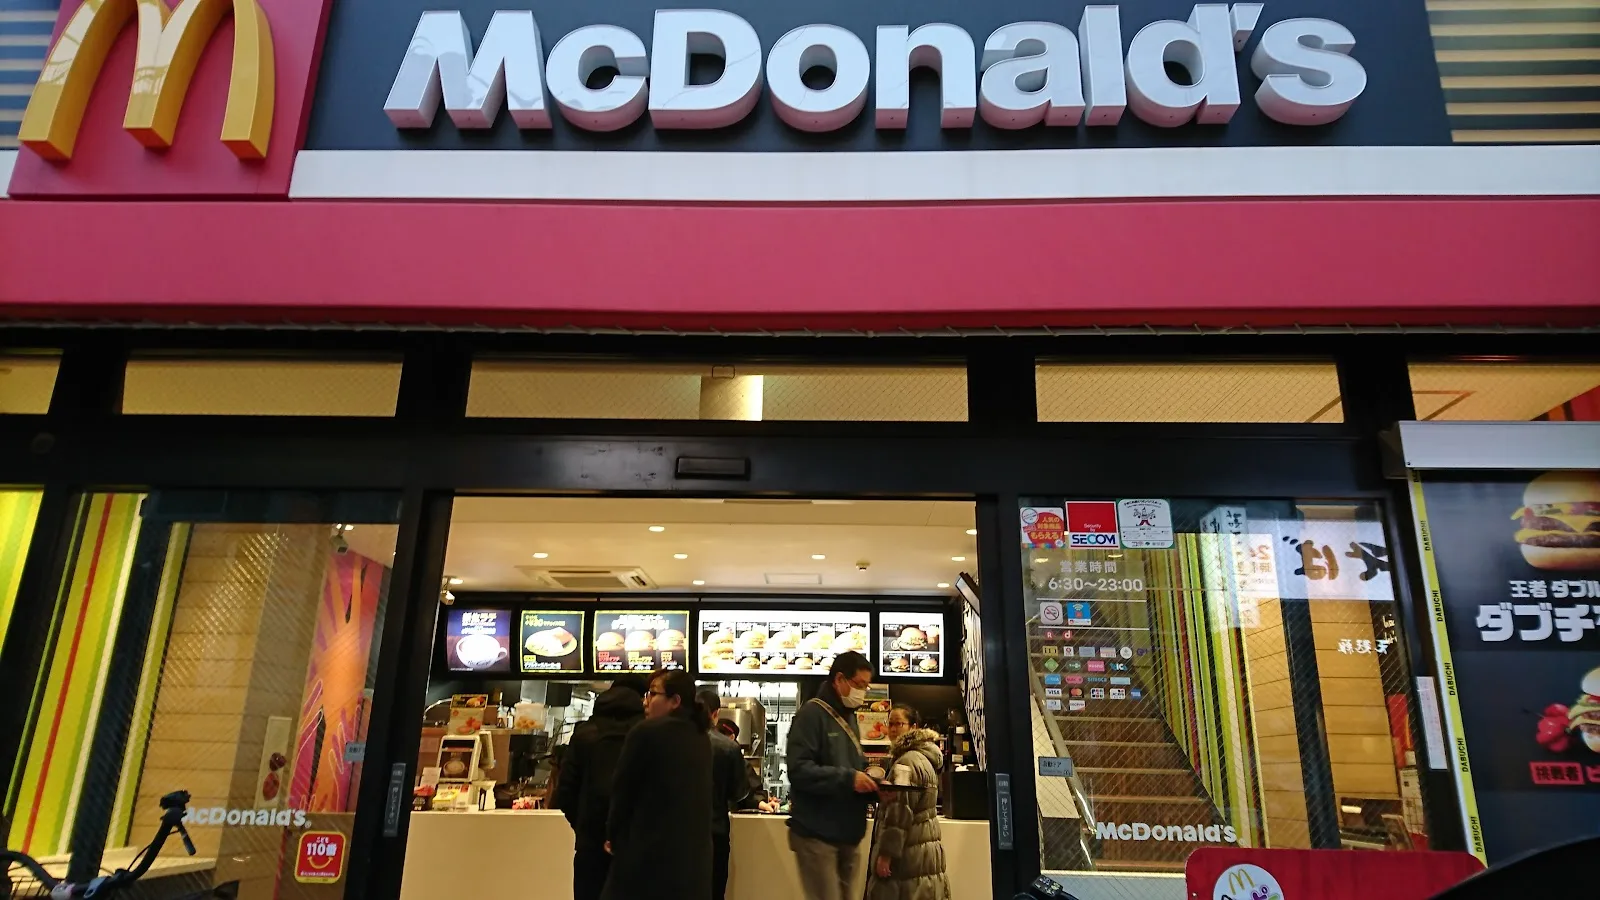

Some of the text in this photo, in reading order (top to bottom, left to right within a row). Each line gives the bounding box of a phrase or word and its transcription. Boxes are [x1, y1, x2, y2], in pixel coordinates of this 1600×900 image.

[384, 2, 1367, 132] McDonald's
[1071, 533, 1116, 545] SECOM
[1420, 520, 1431, 551] DABUCHI
[1059, 560, 1118, 574] 営業時間
[1509, 579, 1600, 598] 王者 ダブル
[1432, 590, 1443, 622] DABUCHI
[1475, 602, 1600, 642] ダブチ
[1444, 662, 1456, 696] DABUCHI
[1457, 737, 1469, 773] DABUCHI
[1095, 821, 1237, 843] McDonald's
[1471, 816, 1483, 852] DABUCHI
